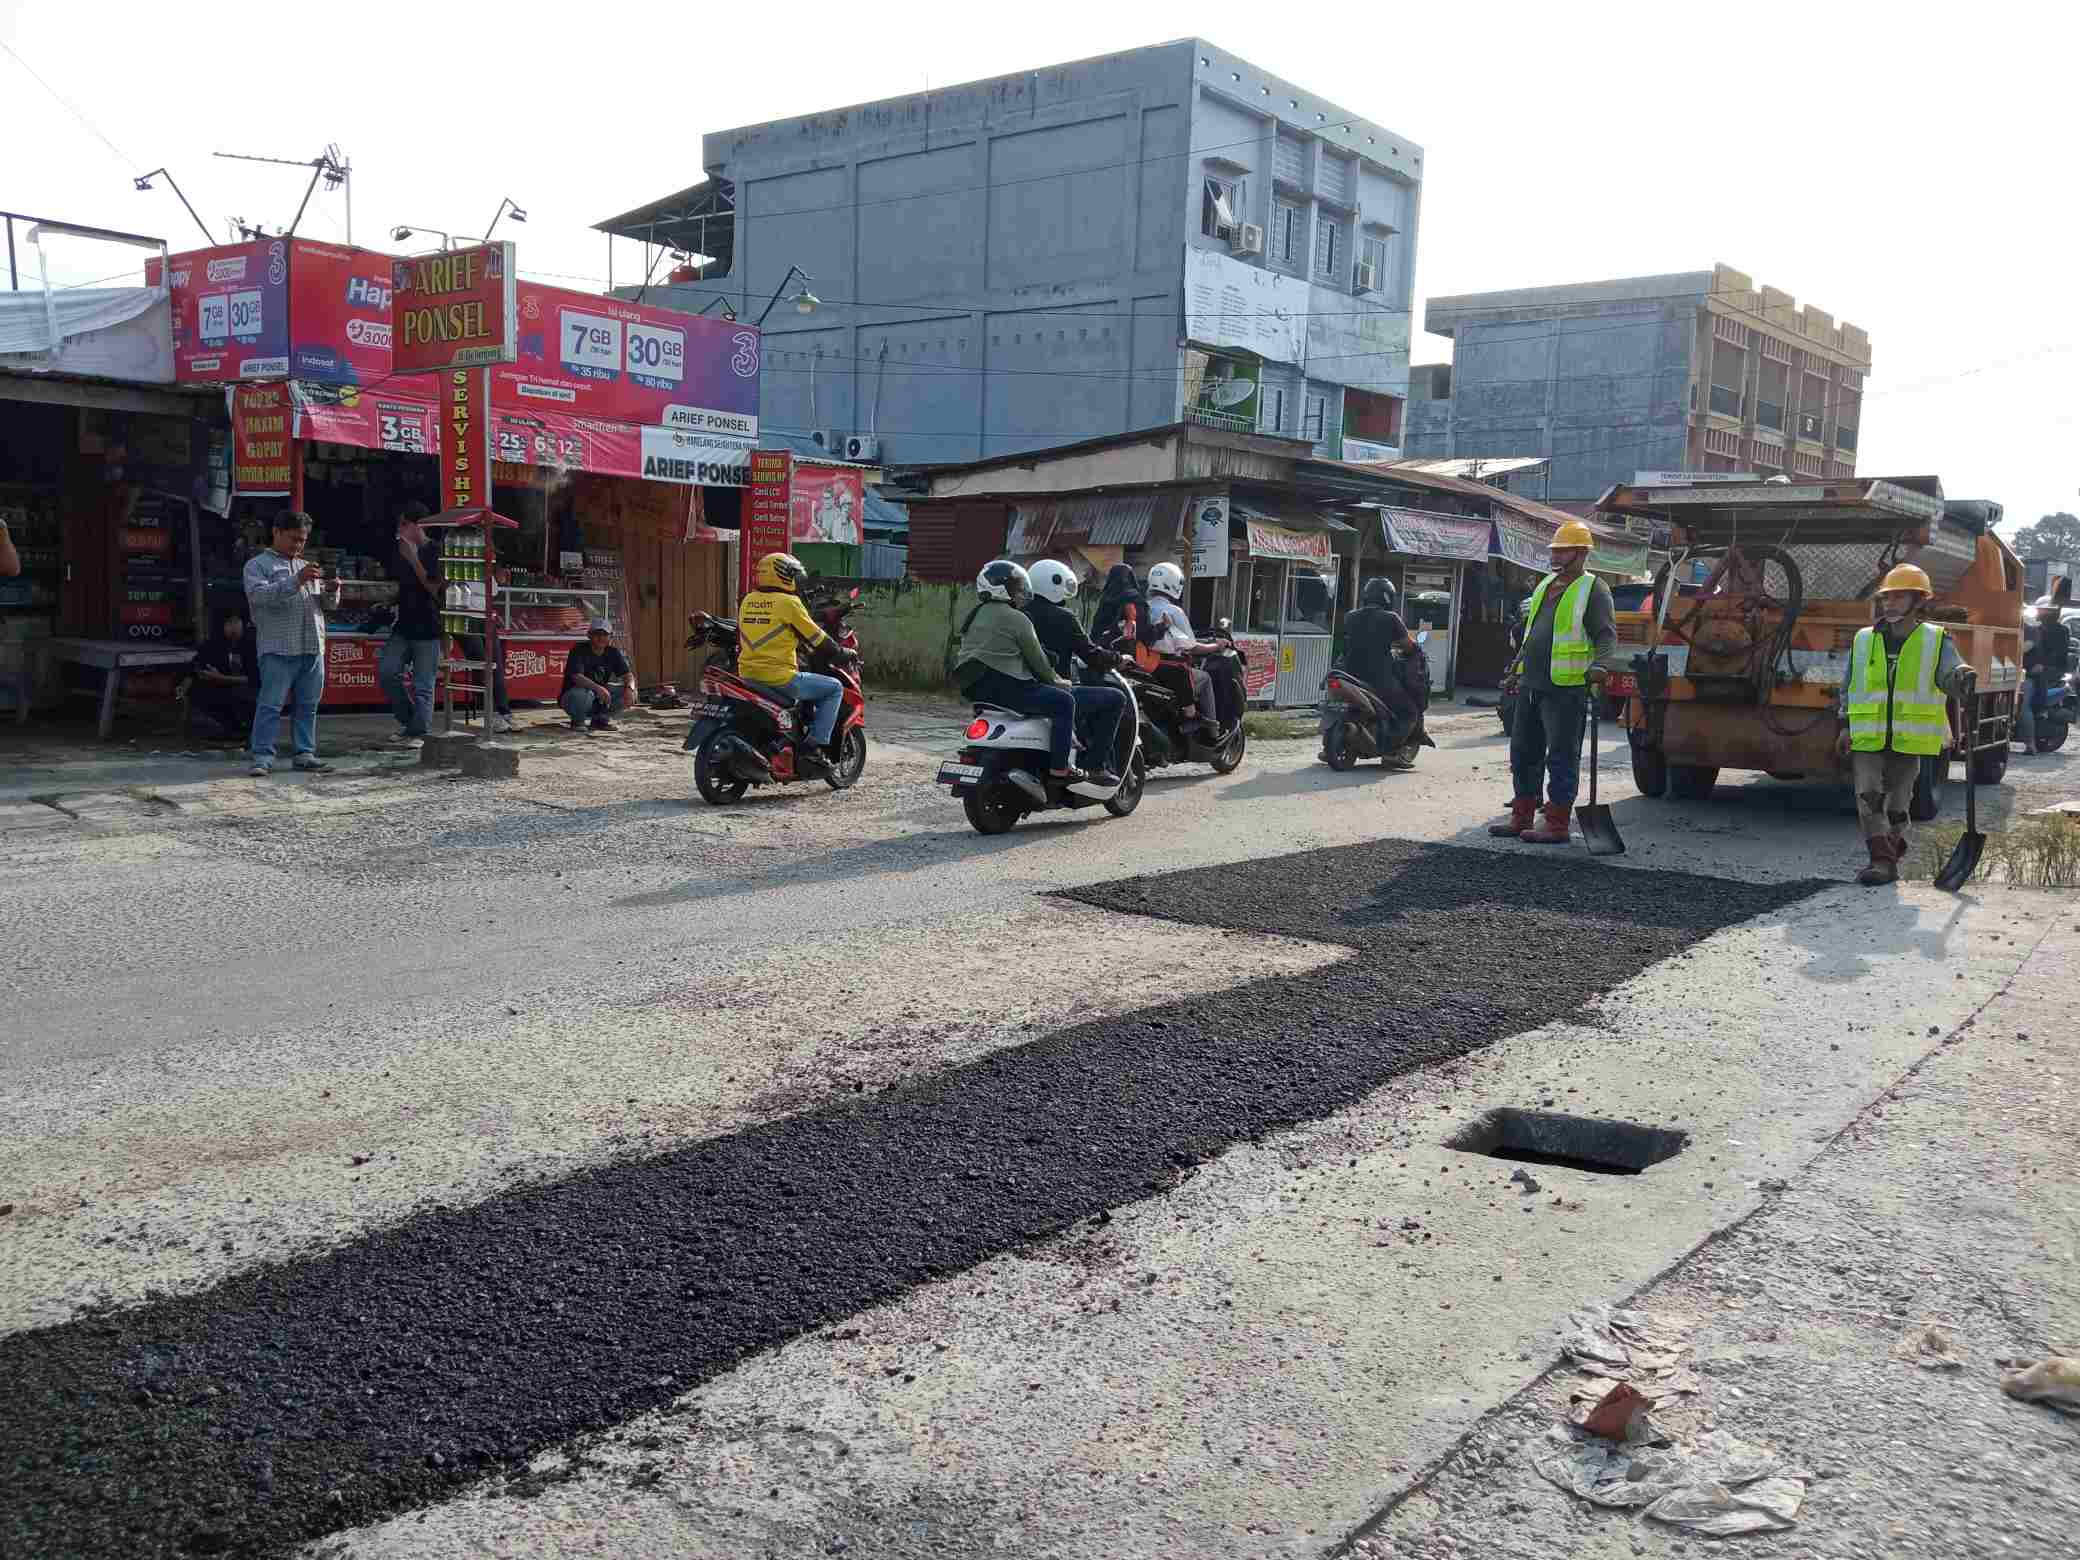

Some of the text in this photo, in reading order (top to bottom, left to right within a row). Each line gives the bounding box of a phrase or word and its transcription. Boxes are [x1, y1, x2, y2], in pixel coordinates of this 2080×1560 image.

[414, 252, 478, 296] ARIEF
[403, 301, 490, 345] PONSEL
[570, 323, 683, 367] 7 GB 30 GB
[381, 416, 398, 441] 3
[401, 426, 421, 439] GB
[452, 371, 471, 507] SERVIS HP
[671, 411, 751, 432] ARIEF PONSEL
[500, 433, 520, 449] 25
[644, 456, 754, 485] ARIEF PONSE
